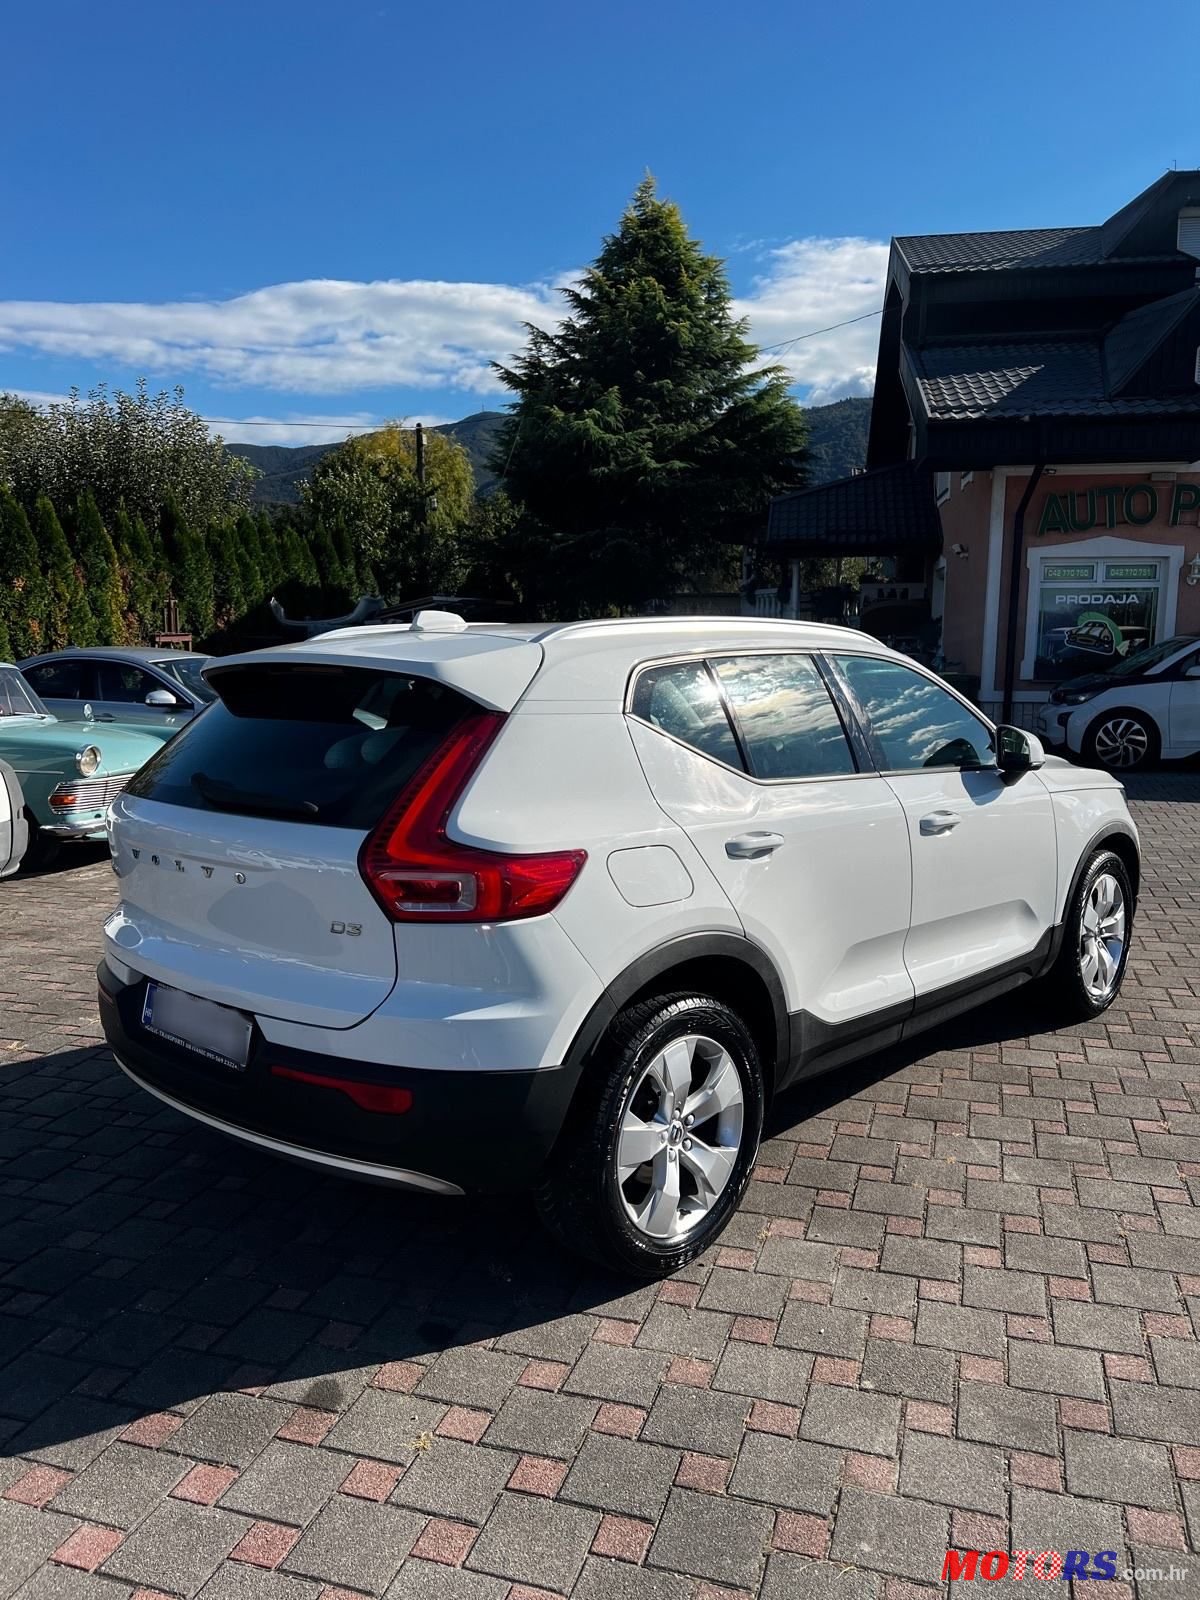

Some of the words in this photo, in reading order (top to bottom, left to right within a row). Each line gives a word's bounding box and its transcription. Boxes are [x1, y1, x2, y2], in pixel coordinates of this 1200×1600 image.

[1038, 484, 1158, 536] AUTO
[1055, 594, 1140, 605] PRODAJA
[131, 848, 247, 885] VOLVO
[330, 921, 362, 937] D3
[144, 1008, 152, 1018] HR
